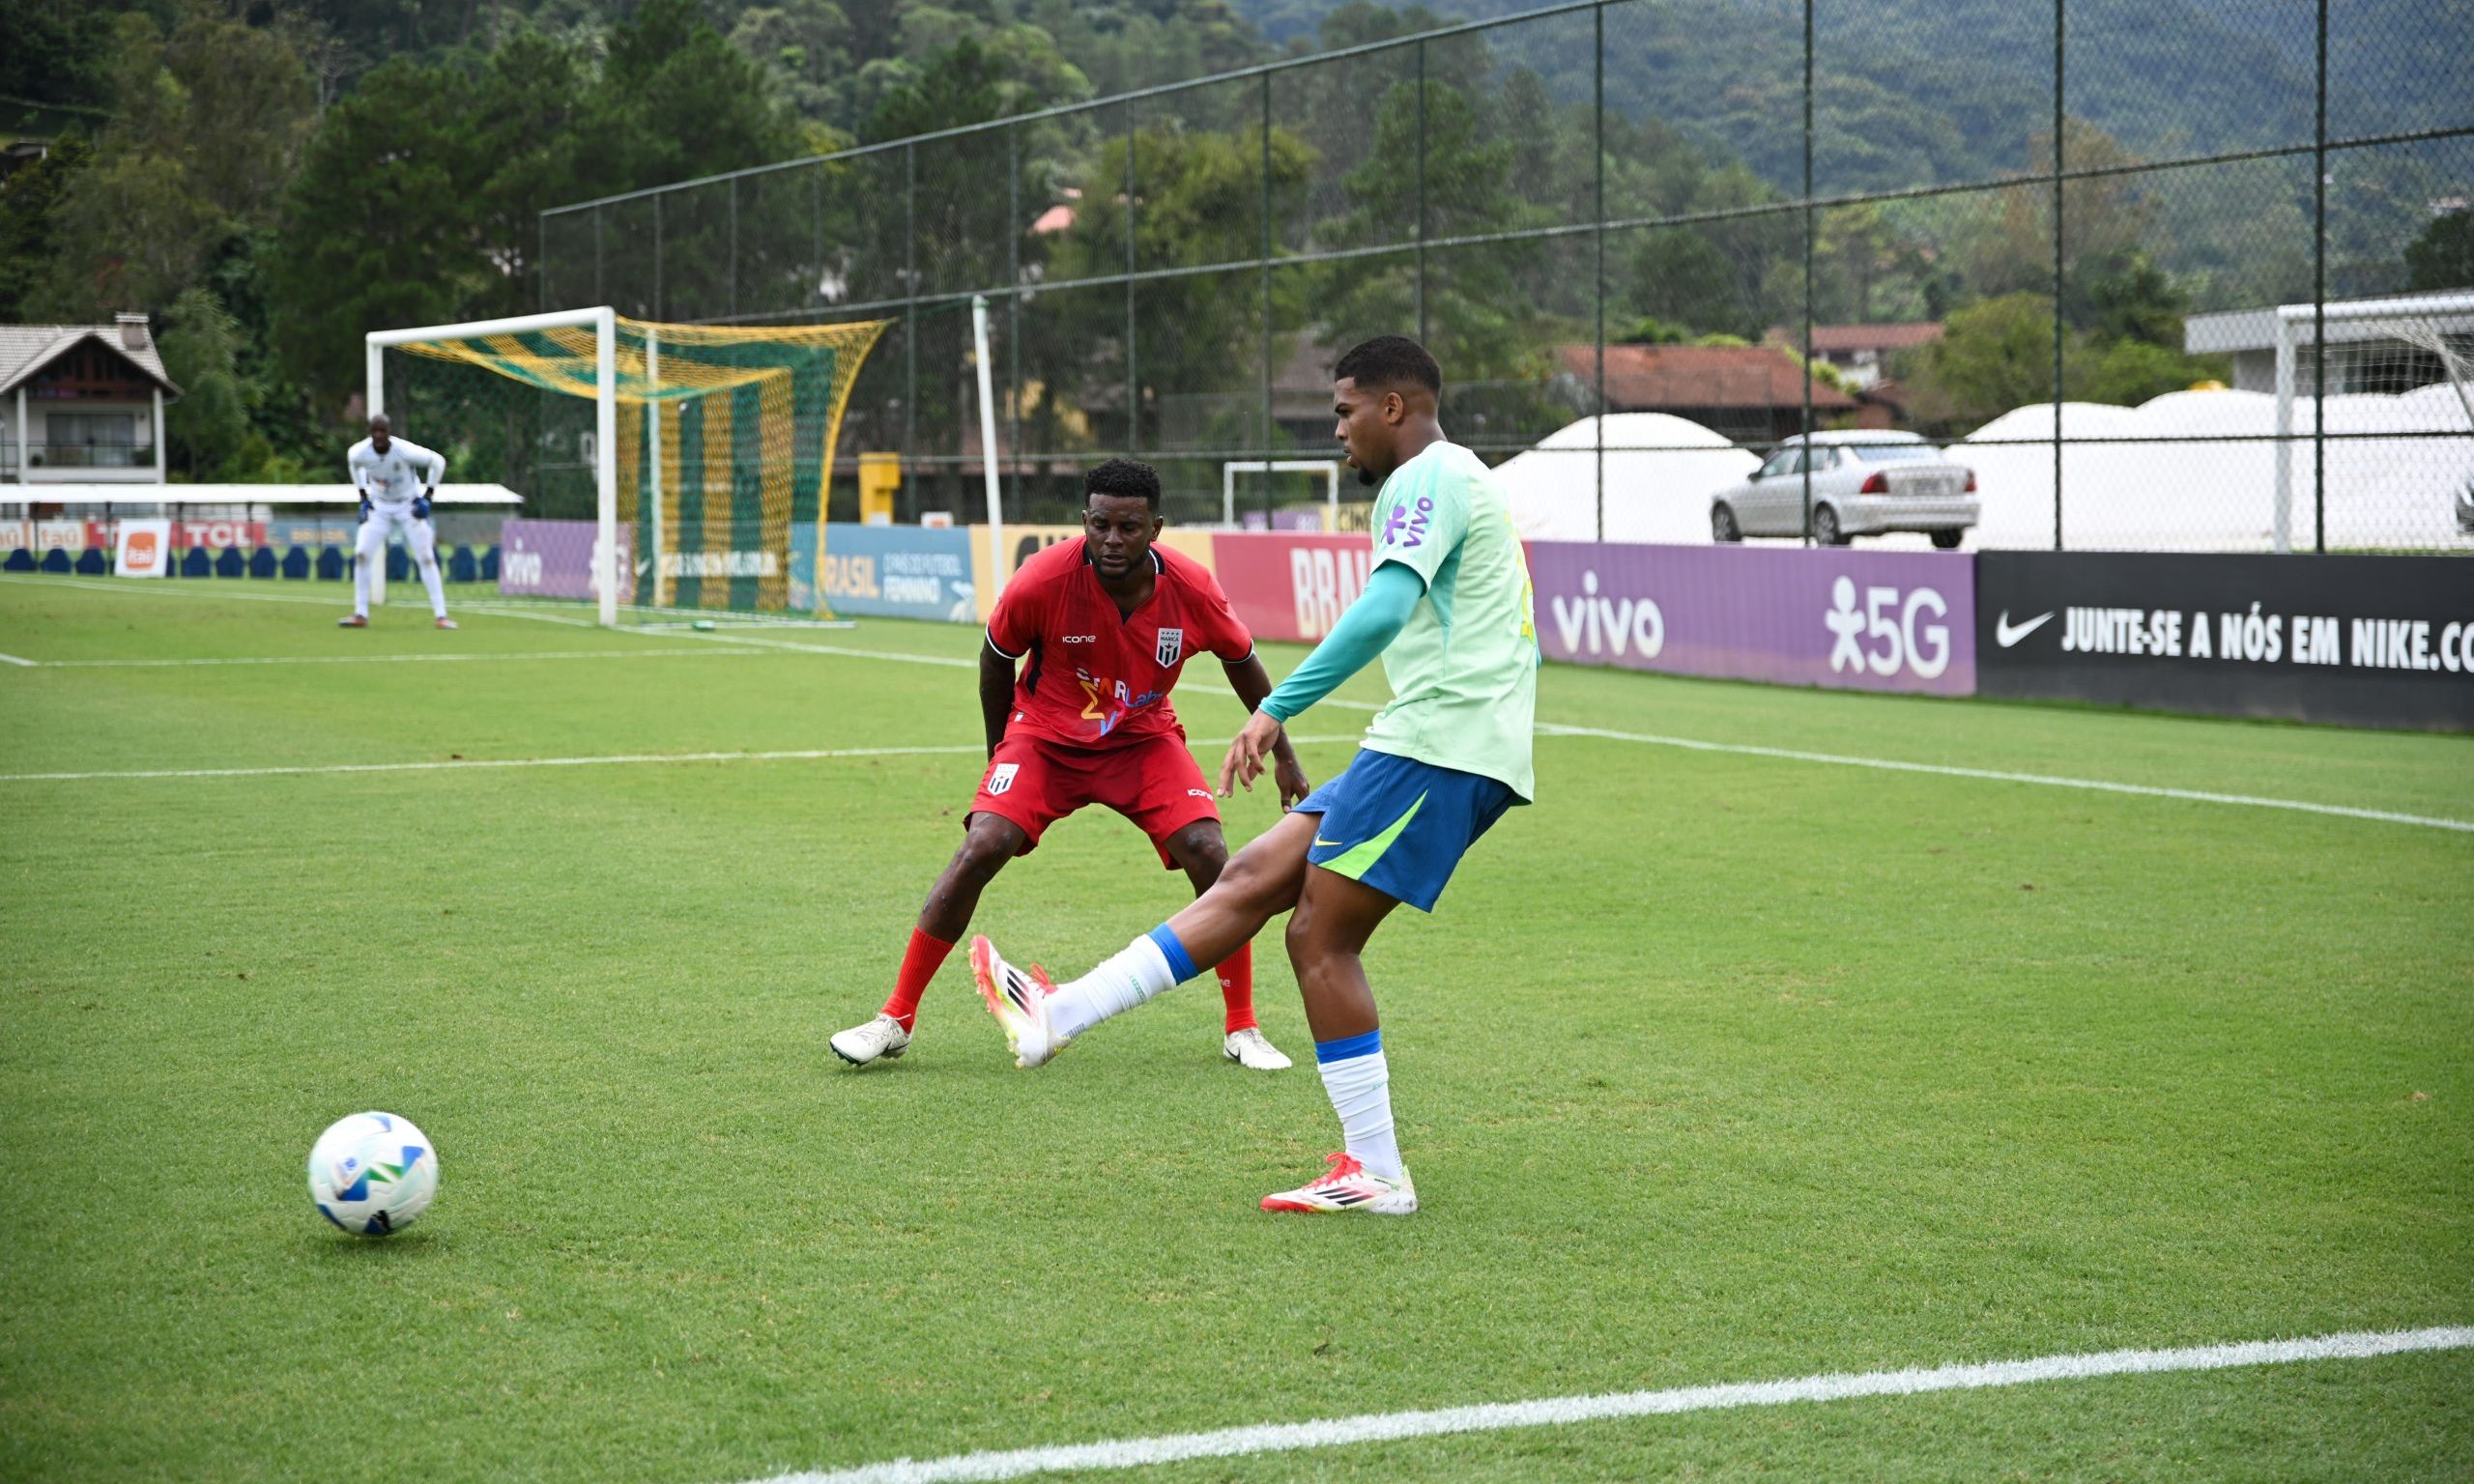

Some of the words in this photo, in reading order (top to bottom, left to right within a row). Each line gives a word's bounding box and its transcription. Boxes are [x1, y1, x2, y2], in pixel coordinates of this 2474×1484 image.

[186, 523, 249, 548] TCL
[1403, 497, 1434, 547] vivo
[127, 546, 156, 565] itaú
[503, 537, 542, 585] vivo
[822, 554, 880, 598] RASIL
[1551, 570, 1664, 659] vivo
[1866, 586, 1950, 678] 5G
[2061, 607, 2182, 656] JUNTE-SE
[2189, 612, 2212, 659] A
[2221, 601, 2283, 663] NÓS
[2291, 615, 2341, 666] EM
